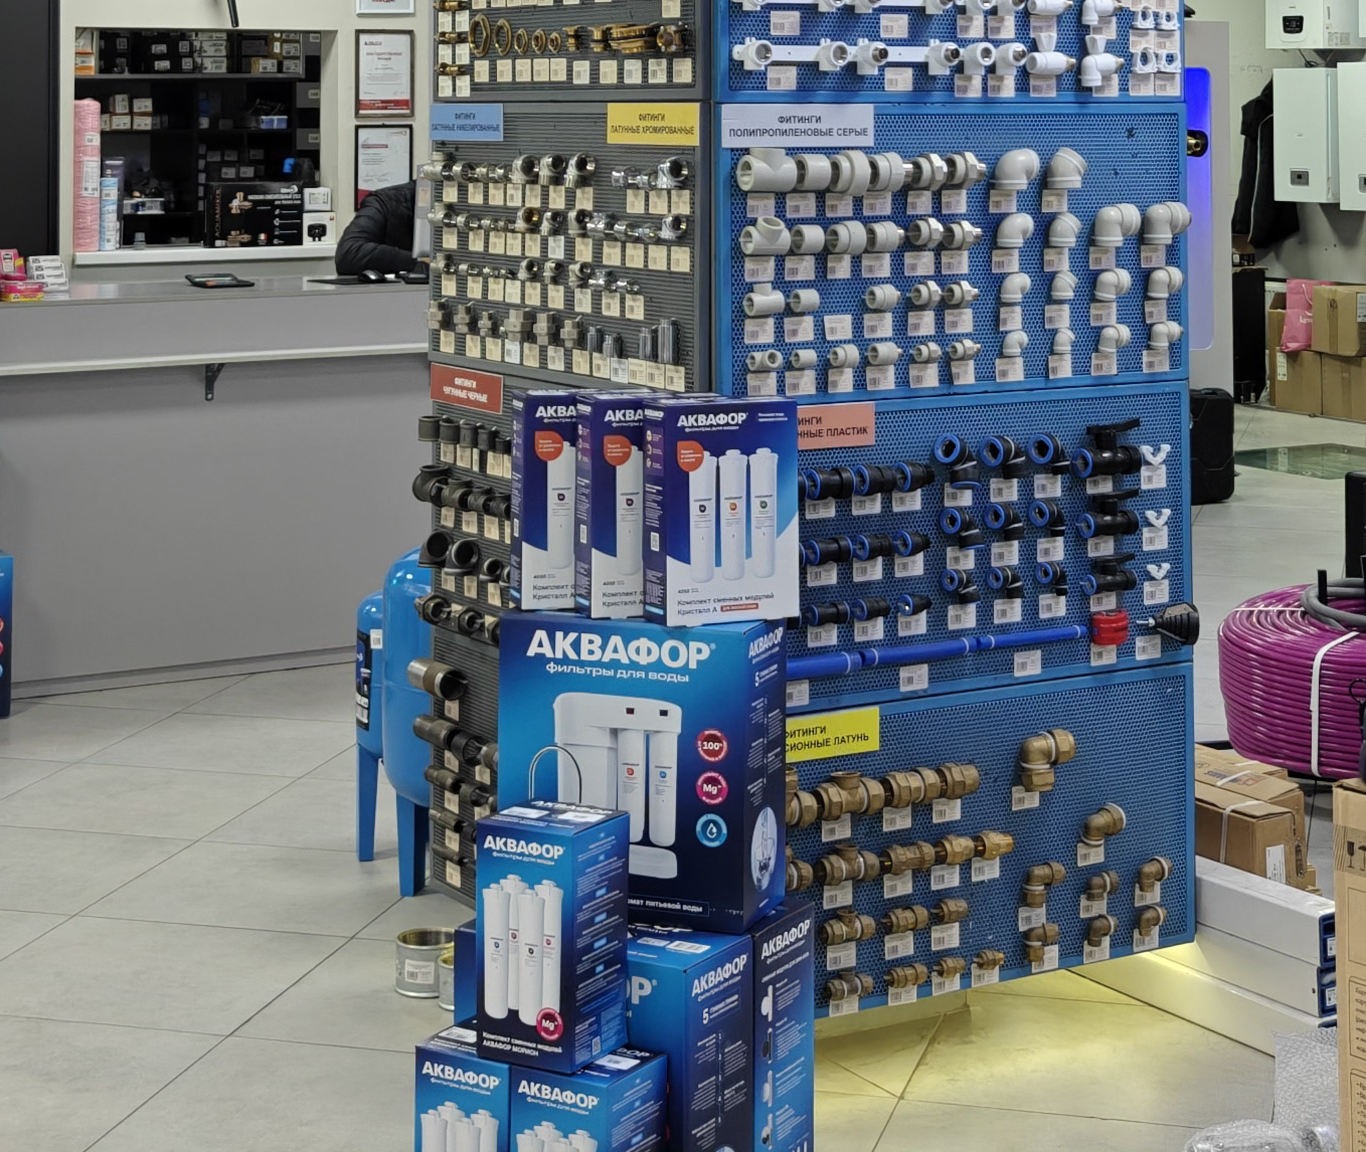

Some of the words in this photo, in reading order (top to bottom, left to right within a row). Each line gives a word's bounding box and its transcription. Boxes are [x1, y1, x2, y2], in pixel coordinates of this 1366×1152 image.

[638, 113, 666, 122] ФИТИНГИ
[778, 115, 822, 124] ФИТИНГИ
[611, 125, 640, 135] ЛАТУННЫЕ
[642, 125, 695, 136] ХРОМИРОВАННЫЕ
[729, 128, 834, 138] ПОЛИПРОПИЛЕНОВЫЕ
[836, 127, 869, 137] СЕРЫЕ
[677, 412, 747, 428] АКВАФОР
[825, 426, 869, 438] ПЛАСТИК
[532, 592, 569, 601] Кристалл
[677, 597, 712, 607] Комплект
[602, 599, 638, 608] Кристалл
[677, 607, 711, 616] Кристалл
[526, 629, 711, 669] АКВАФОР
[748, 627, 783, 659] АКВАФОР
[546, 661, 614, 678] фильтры
[616, 667, 646, 680] для
[648, 671, 690, 683] воды
[833, 733, 870, 746] ЛАТУНЬ
[484, 835, 564, 859] АКВАФОР
[761, 920, 811, 960] АКВАФОР
[692, 954, 748, 998] АКВАФОР
[422, 1061, 500, 1089] АКВАФОР
[518, 1080, 599, 1109] АКВАФОР
